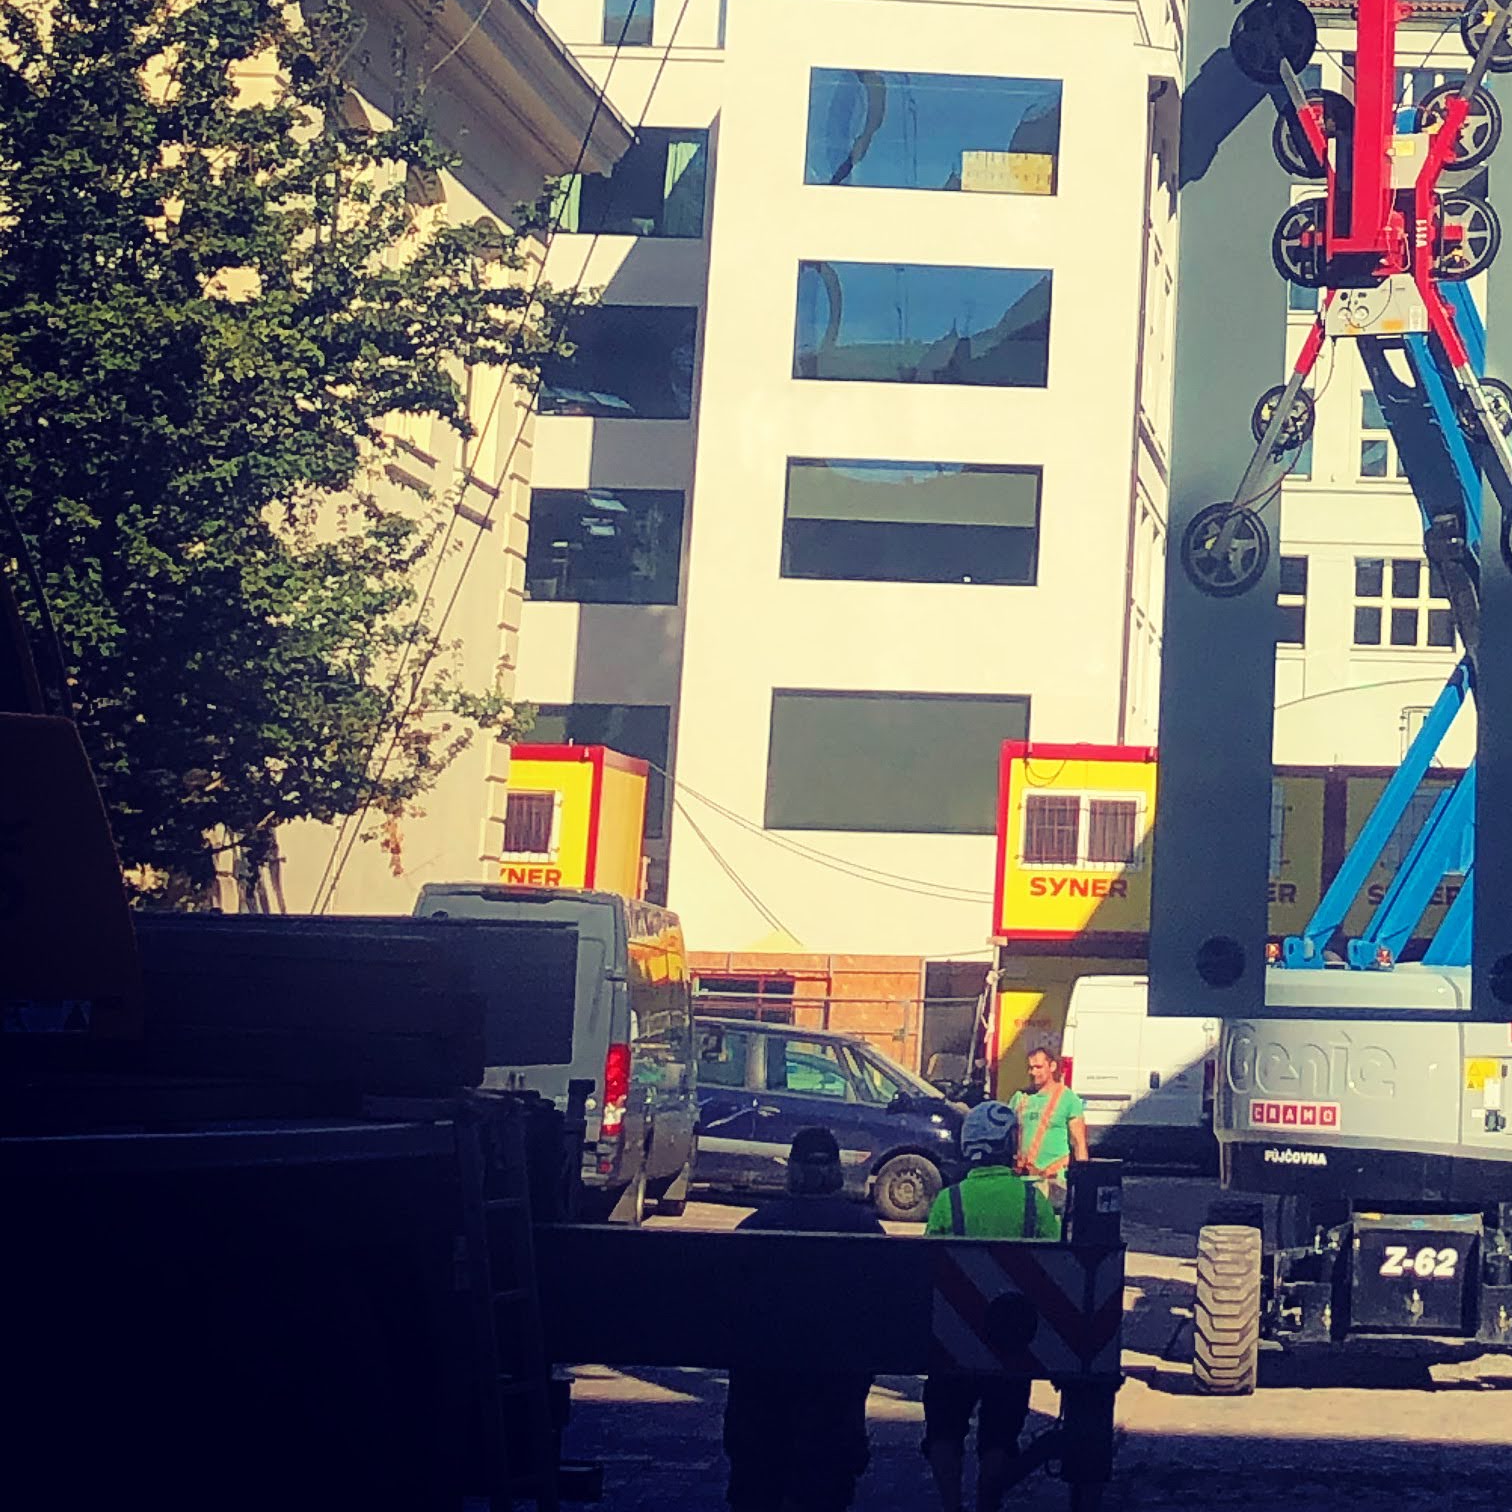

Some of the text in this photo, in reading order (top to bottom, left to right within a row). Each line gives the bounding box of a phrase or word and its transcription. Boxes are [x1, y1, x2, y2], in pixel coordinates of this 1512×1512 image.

[500, 868, 562, 886] NER
[1030, 877, 1127, 898] SYNER
[1252, 1105, 1336, 1124] CRAMO
[1379, 1246, 1459, 1278] Z-62
